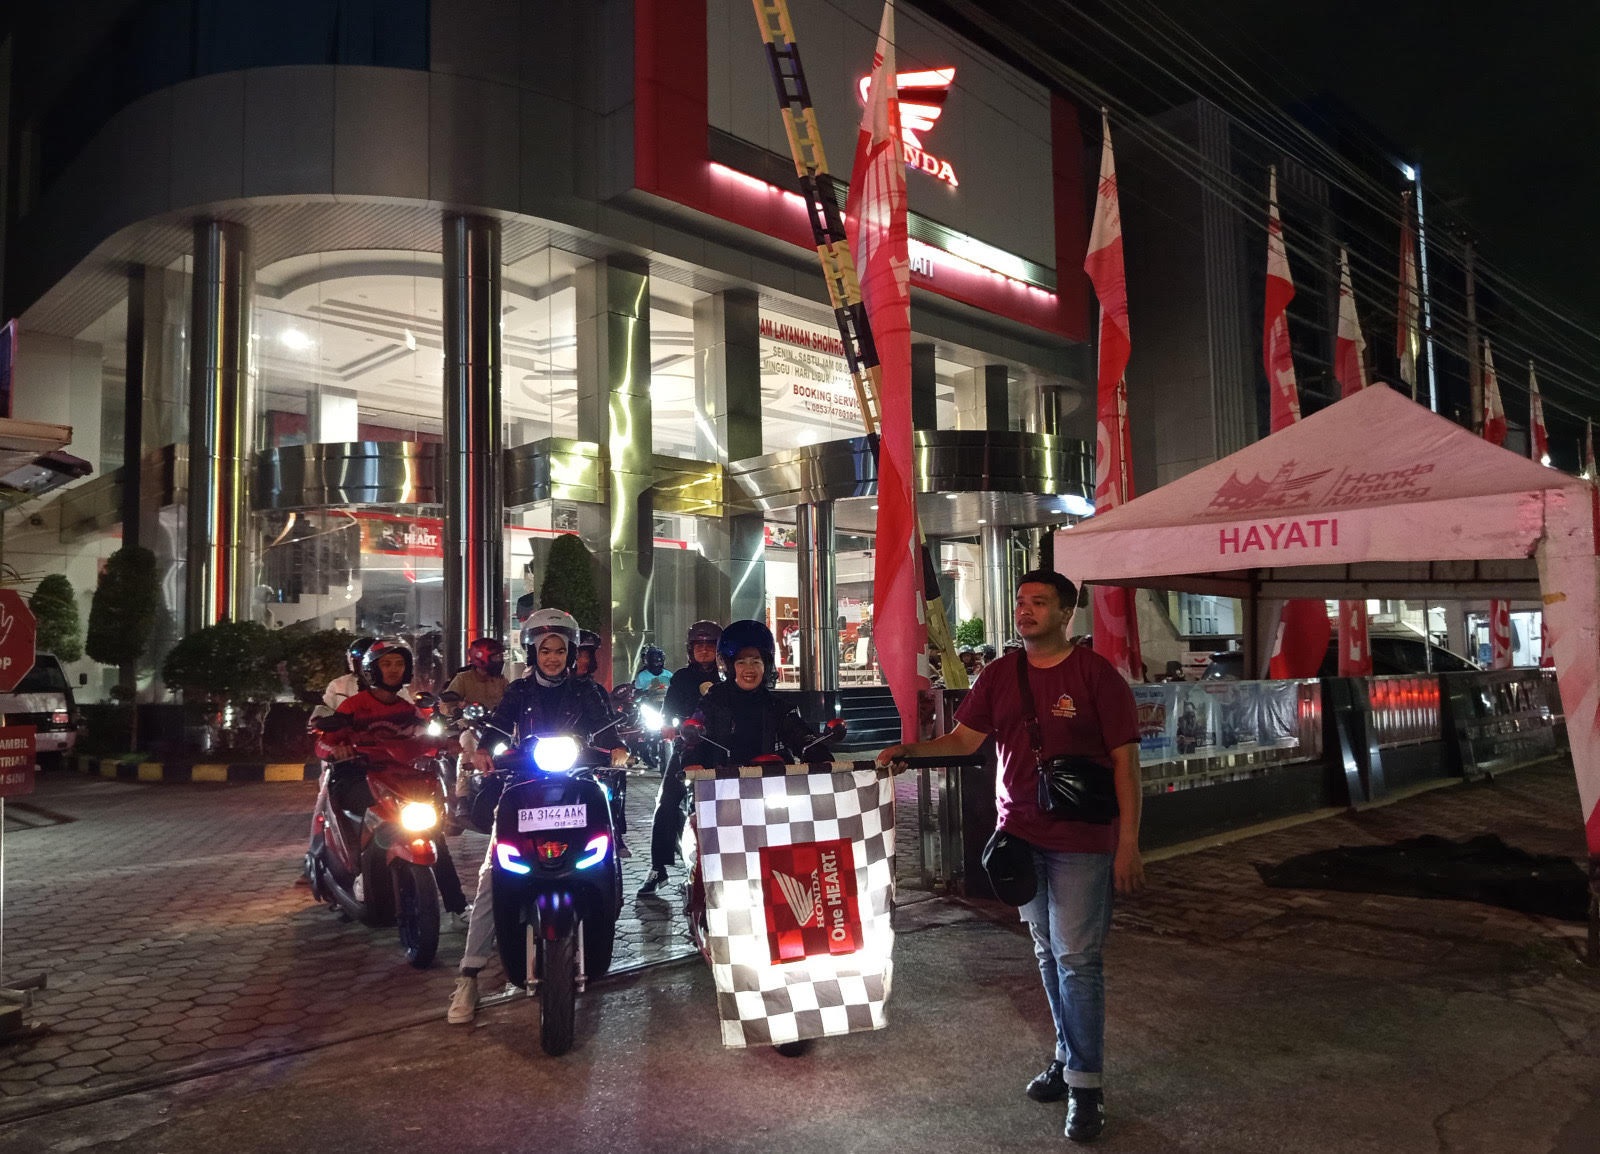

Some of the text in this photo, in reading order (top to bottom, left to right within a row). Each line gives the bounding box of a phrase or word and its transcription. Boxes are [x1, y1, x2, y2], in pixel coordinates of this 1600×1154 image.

[904, 142, 959, 187] NDA
[760, 318, 773, 337] AM
[774, 322, 810, 348] LAYANAN
[773, 346, 795, 361] SENIN
[798, 351, 820, 367] SABTU
[763, 360, 790, 375] MINGGU
[795, 366, 810, 379] HARI
[793, 384, 860, 410] BOOKING SERVIC
[1342, 463, 1435, 485] Honda
[1325, 487, 1431, 507] Minang
[1334, 477, 1416, 497] Untuk
[1219, 519, 1338, 555] HAYATI
[0, 755, 27, 768] TRIAN
[520, 806, 584, 821] BA 3144 AAK
[811, 868, 825, 928] HONDA
[821, 850, 846, 942] One HEART.
